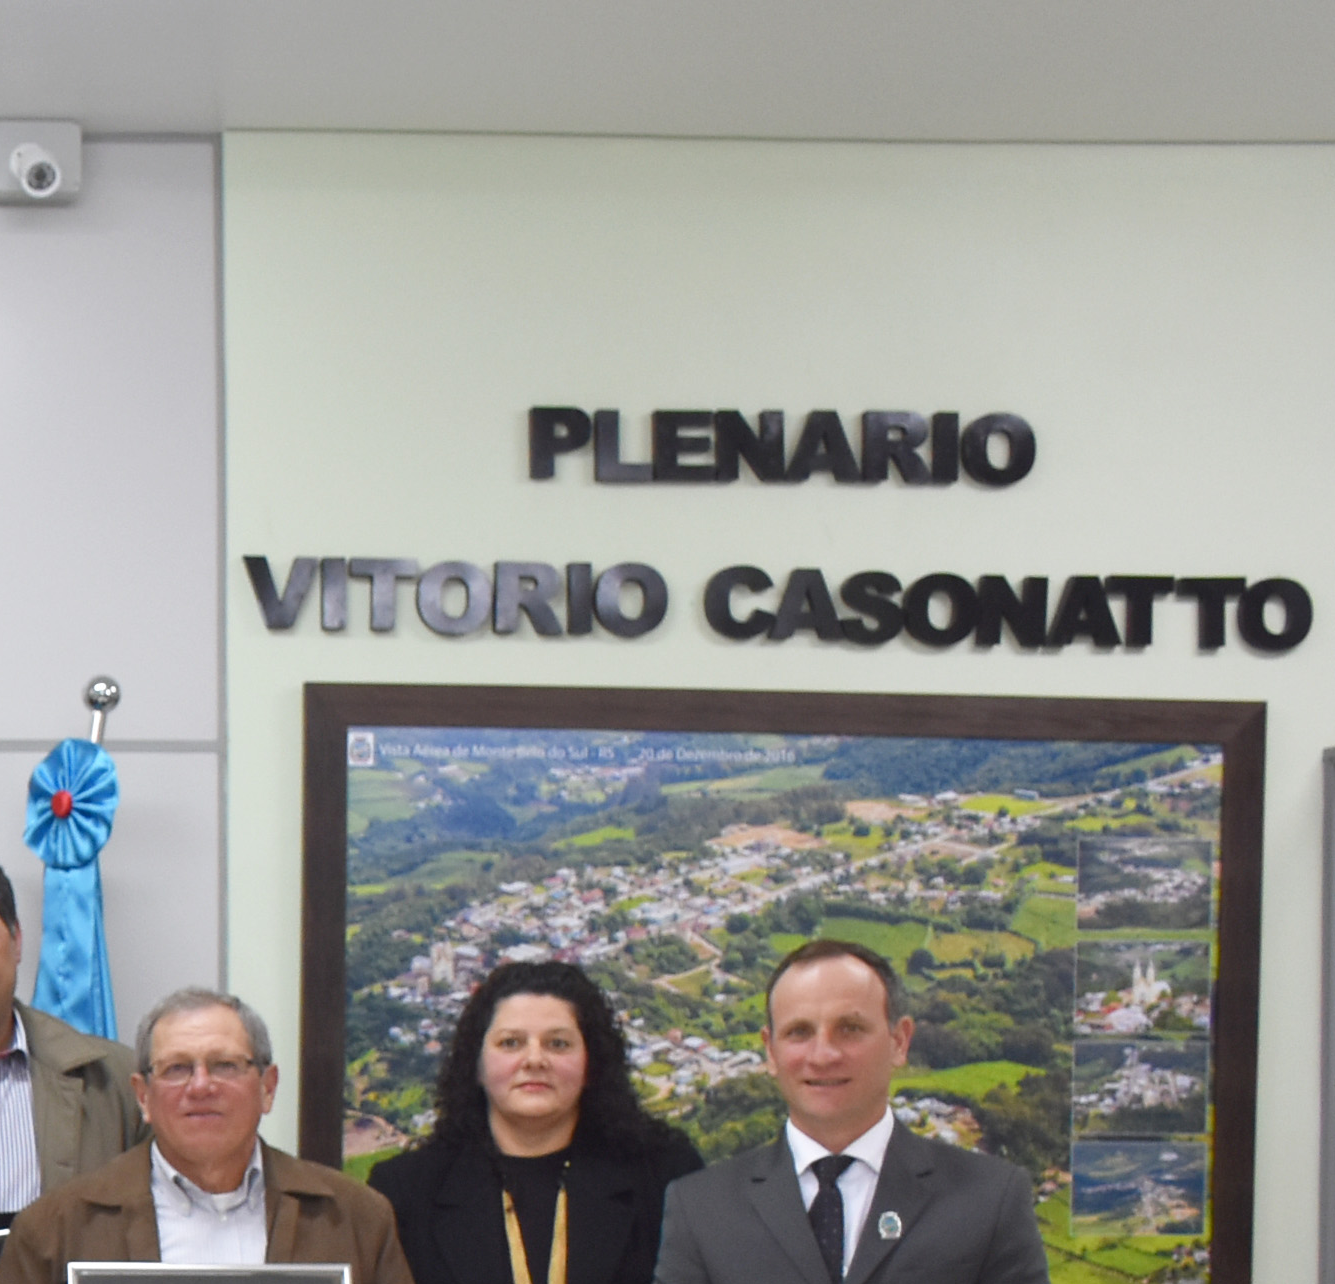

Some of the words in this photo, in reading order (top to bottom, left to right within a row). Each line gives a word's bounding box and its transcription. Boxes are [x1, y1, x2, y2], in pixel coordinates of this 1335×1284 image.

[529, 406, 1037, 488] PLENARIO
[243, 555, 669, 638] VITORIO
[704, 564, 1314, 654] CASONATTO
[379, 744, 410, 758] Vista
[452, 745, 470, 758] de
[472, 745, 515, 759] Monte
[547, 746, 565, 760] do
[568, 746, 588, 760] Sul
[598, 746, 614, 759] RS
[656, 748, 674, 761] de
[676, 748, 742, 762] Dezembro
[744, 750, 762, 762] de
